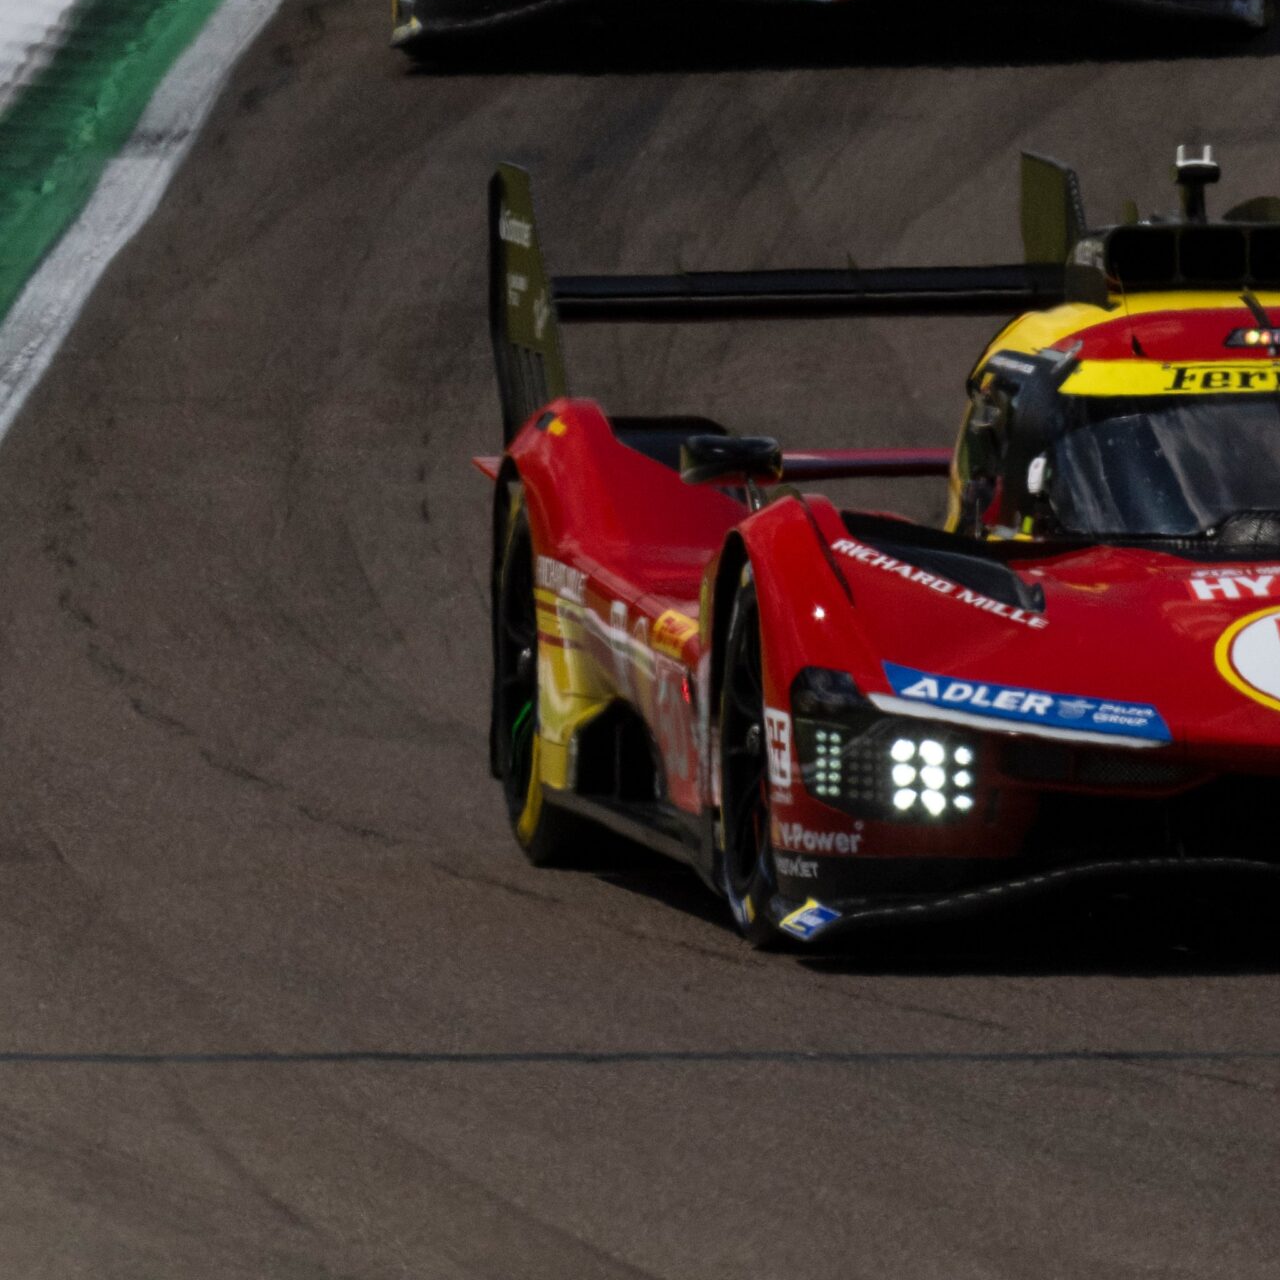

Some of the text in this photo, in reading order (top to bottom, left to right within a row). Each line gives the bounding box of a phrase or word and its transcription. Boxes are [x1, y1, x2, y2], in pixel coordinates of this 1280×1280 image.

[831, 538, 1050, 629] RICHARD MILLE
[1190, 574, 1274, 600] HY
[899, 676, 1055, 716] ADLER
